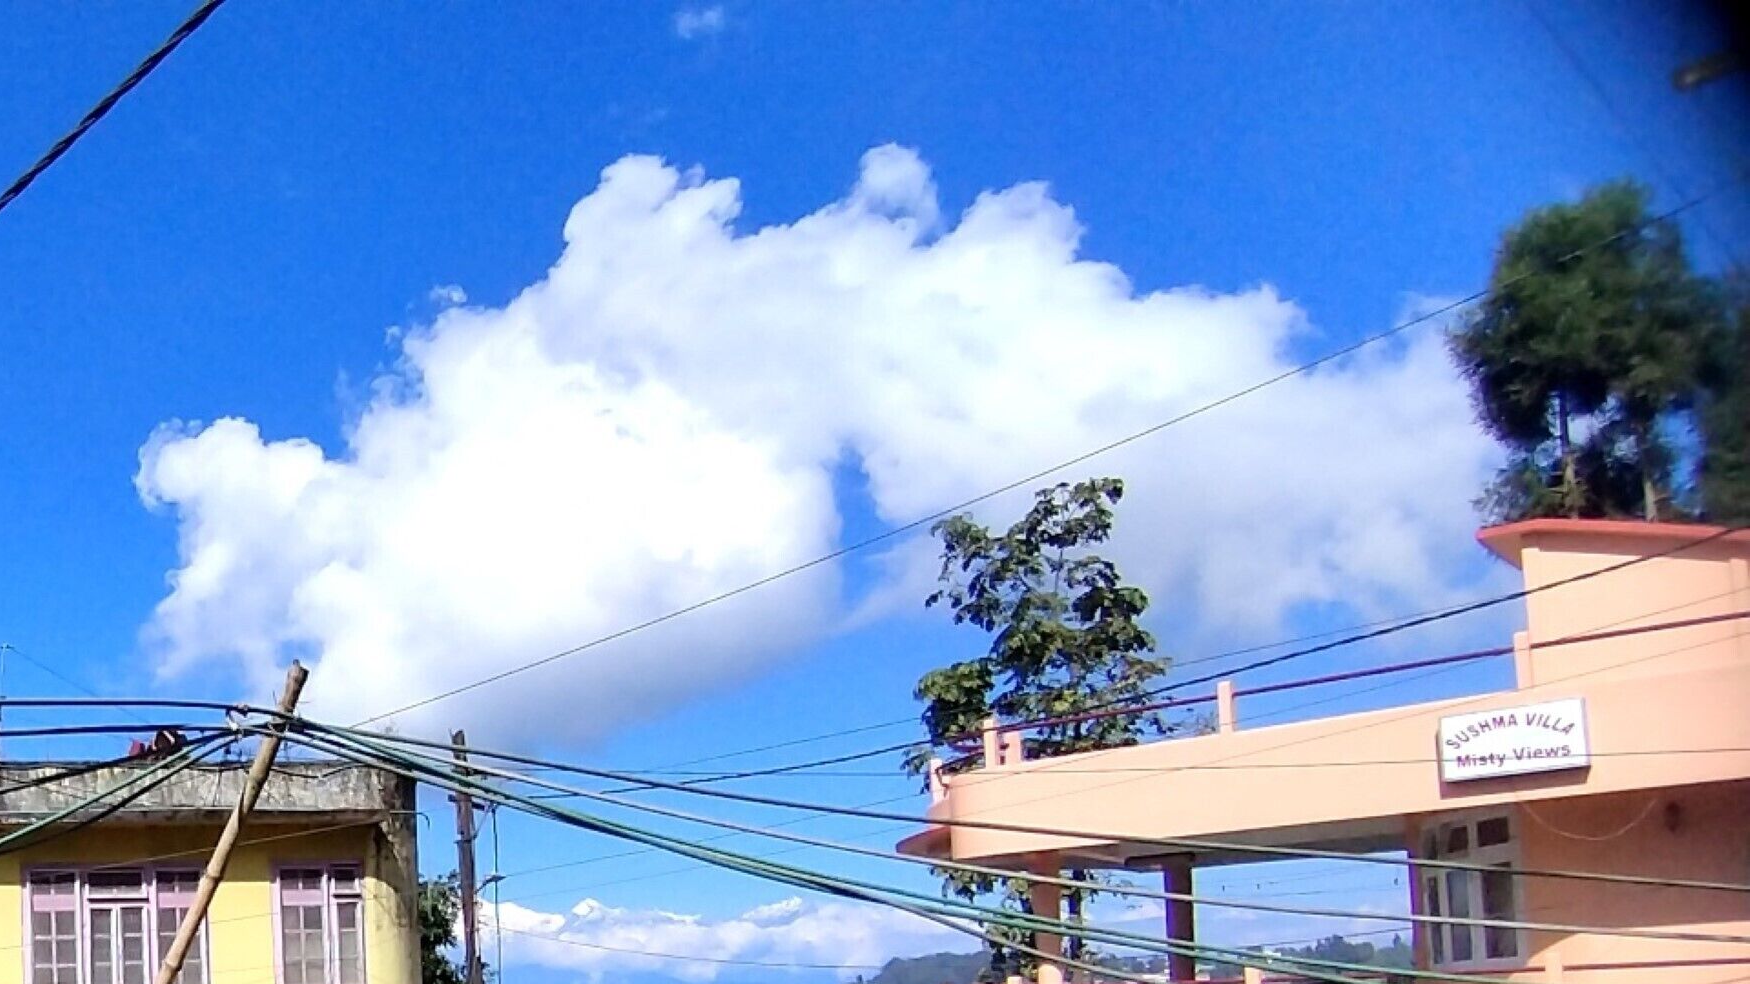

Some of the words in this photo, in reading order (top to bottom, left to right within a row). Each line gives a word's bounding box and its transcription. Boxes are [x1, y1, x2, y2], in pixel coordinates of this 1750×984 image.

[1445, 713, 1519, 749] SUSHMA
[1525, 712, 1576, 736] VILLA
[1456, 752, 1506, 768] Misty
[1512, 745, 1571, 761] Views
